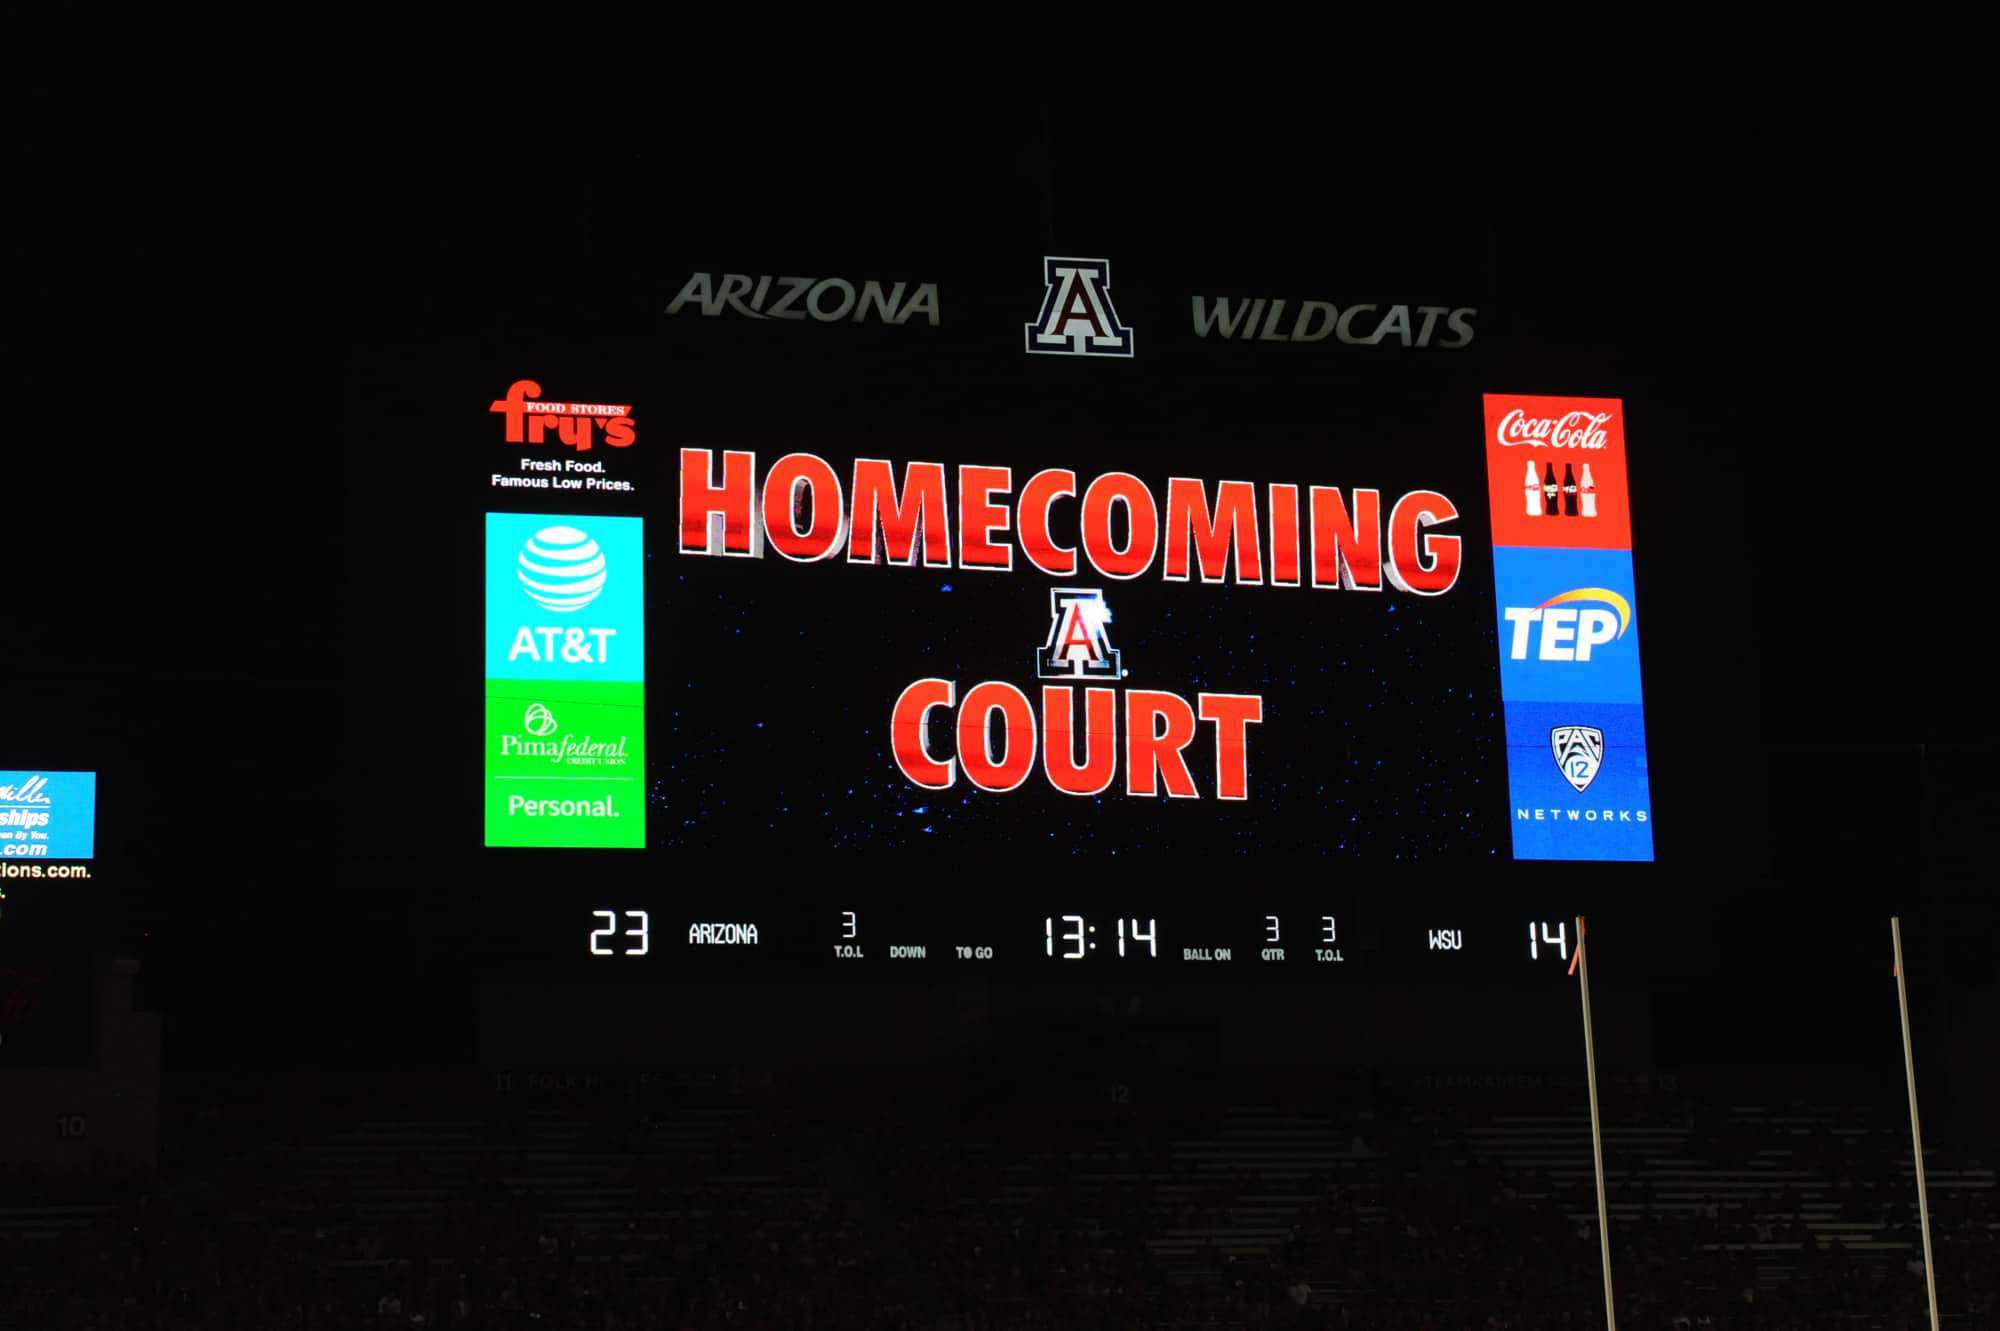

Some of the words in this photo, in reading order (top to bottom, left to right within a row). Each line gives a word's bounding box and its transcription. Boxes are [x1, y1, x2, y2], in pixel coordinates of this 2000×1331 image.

[665, 271, 940, 326] ARIZONA
[1191, 295, 1478, 348] WILDCATS
[489, 379, 636, 452] fry's
[526, 401, 566, 414] FOOD
[570, 403, 625, 416] STORES
[1497, 409, 1614, 450] Coca-Cola
[521, 458, 562, 472] Fresh
[565, 460, 606, 474] Food.
[491, 474, 549, 489] Famous
[552, 476, 582, 490] Low
[586, 478, 635, 492] Prices.
[679, 447, 1463, 597] HOMECOMING
[508, 626, 617, 663] AT&T
[1504, 607, 1618, 662] TEP
[890, 678, 1262, 801] COURT
[1570, 760, 1589, 778] 12
[508, 794, 620, 817] Personal.
[1517, 808, 1648, 822] NETWORKS
[590, 910, 649, 955] 23
[689, 923, 758, 944] ARIZONA
[842, 911, 856, 938] 3
[1266, 916, 1280, 942] 3
[1322, 916, 1336, 942] 3
[1046, 915, 1157, 959] 13:14
[1429, 929, 1462, 950] WSU
[1529, 922, 1567, 960] 14
[834, 945, 864, 958] T.O.L
[890, 946, 926, 958] DOWN
[955, 946, 973, 959] TO
[975, 946, 993, 959] GO
[1183, 948, 1212, 960] BALL
[1215, 948, 1231, 960] ON
[1261, 948, 1285, 960] QTR
[1315, 949, 1344, 961] T.O.L
[56, 1115, 85, 1137] 10
